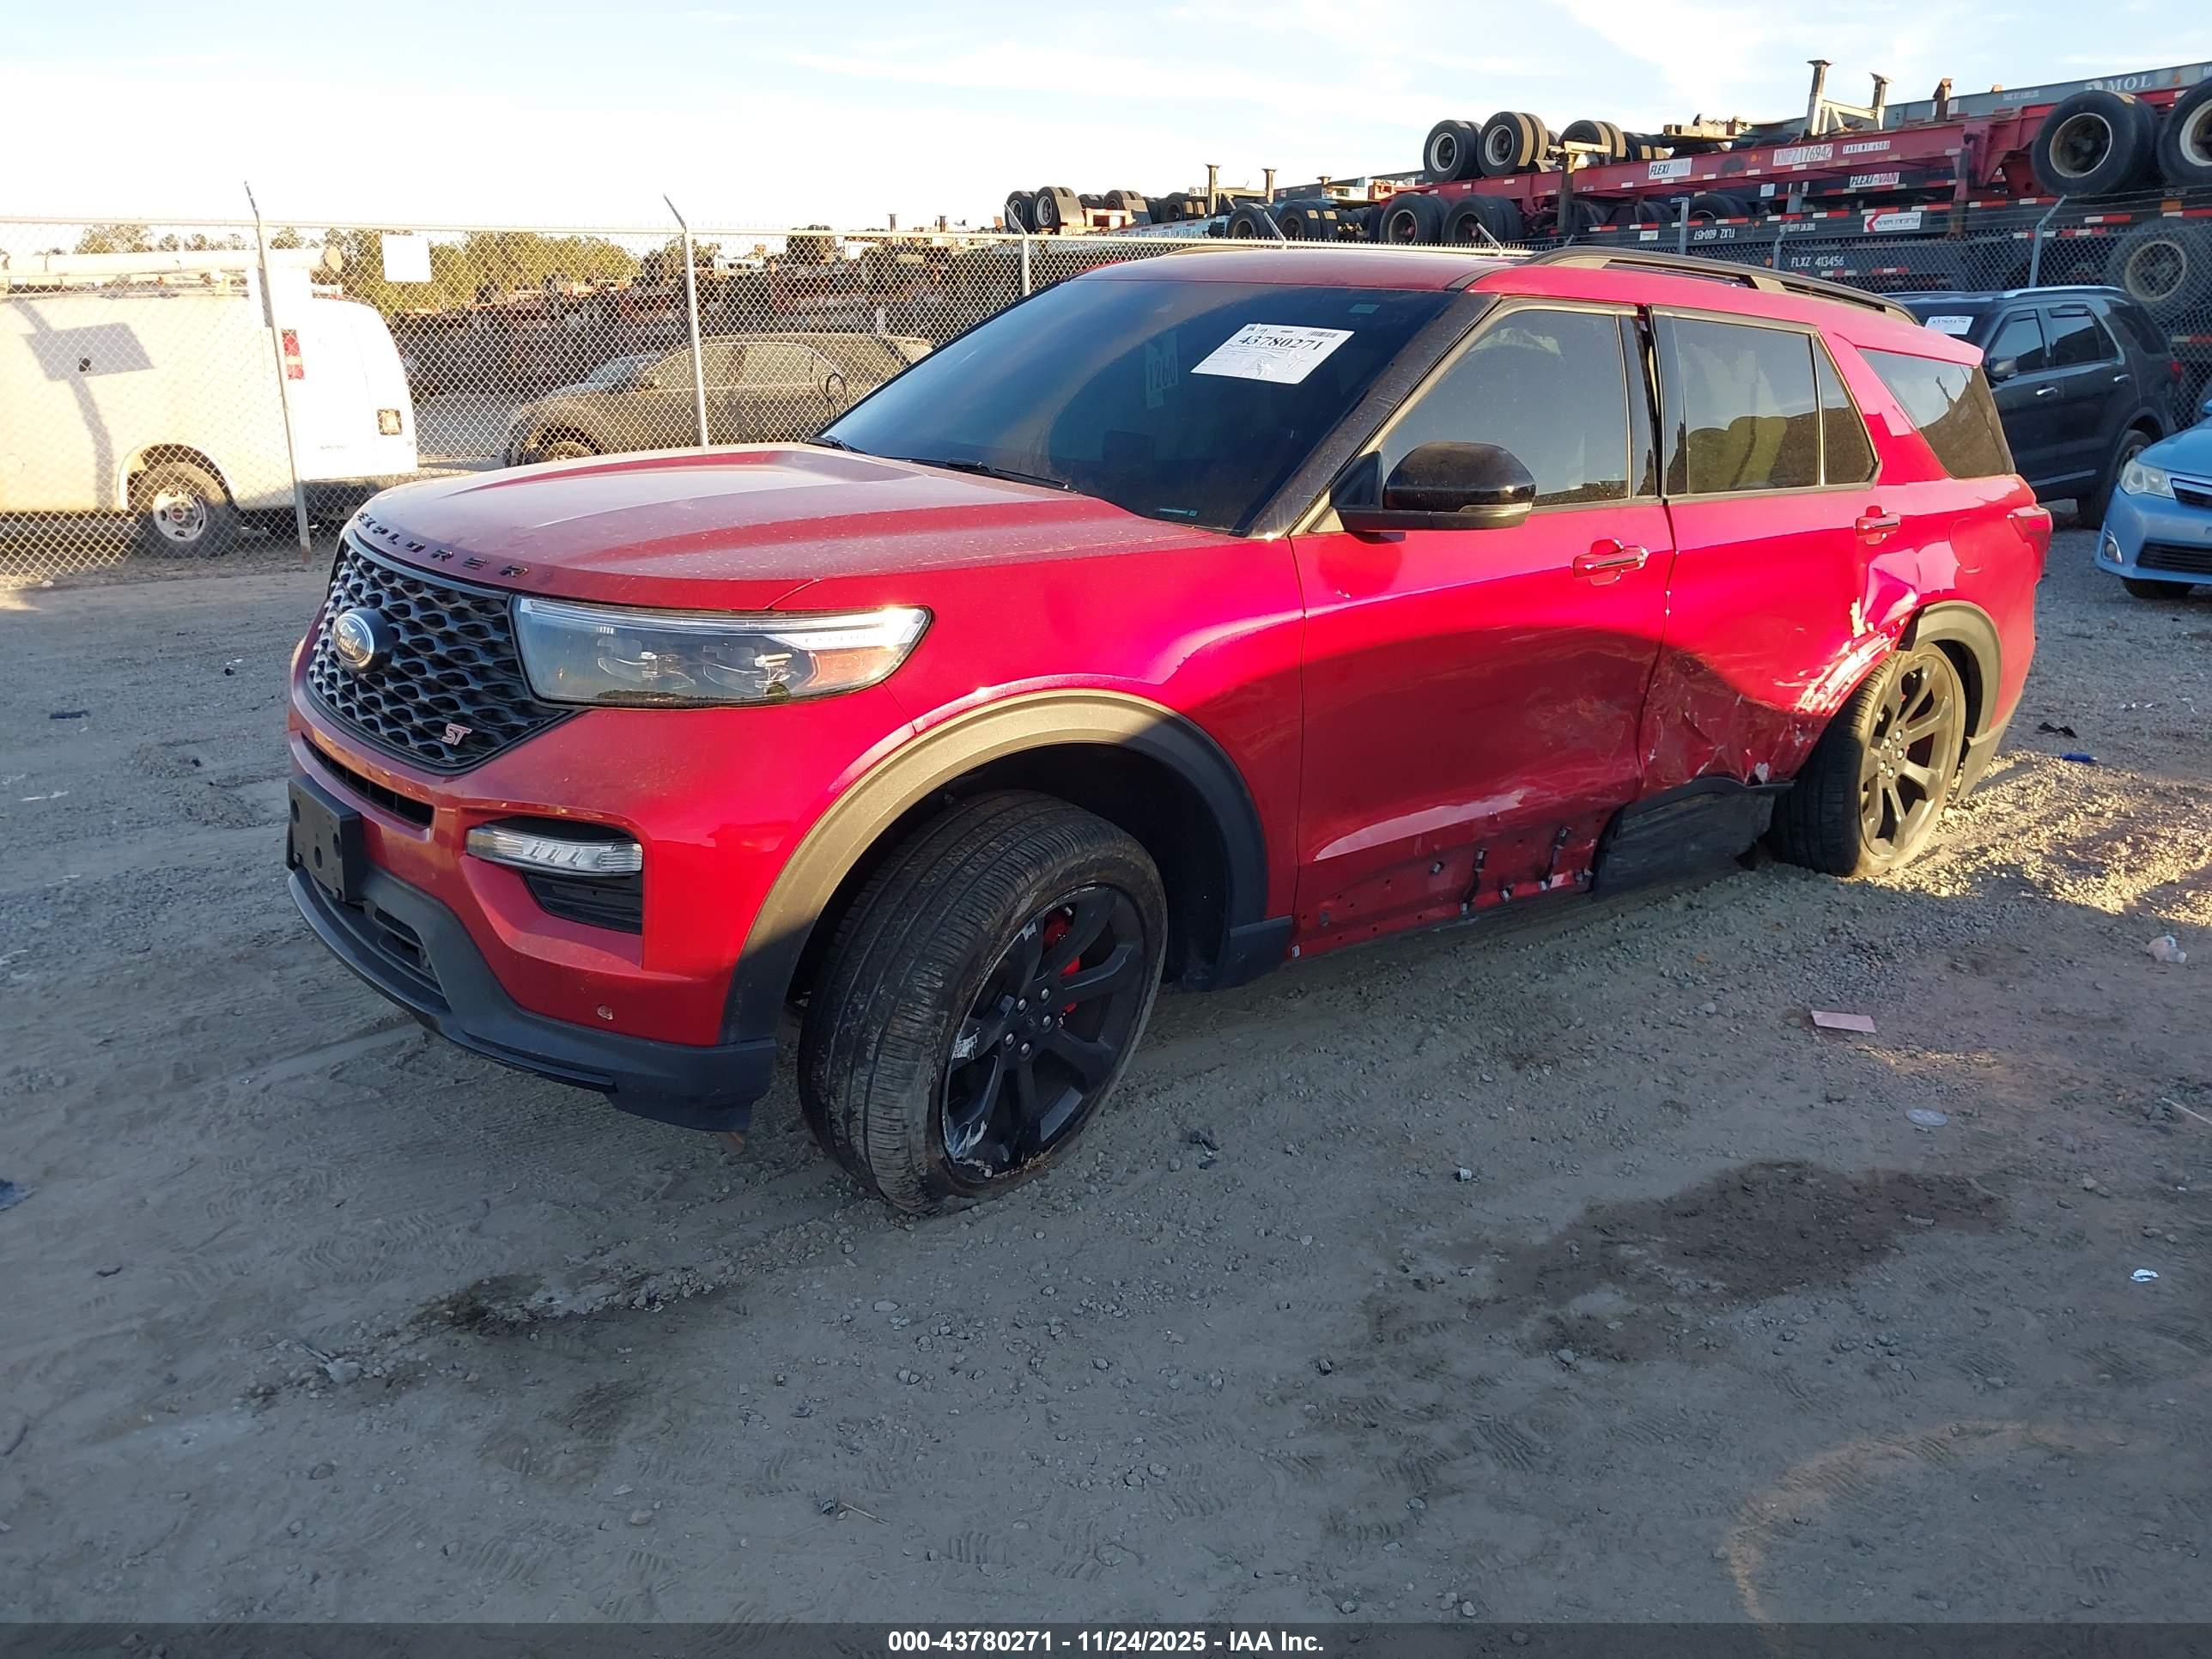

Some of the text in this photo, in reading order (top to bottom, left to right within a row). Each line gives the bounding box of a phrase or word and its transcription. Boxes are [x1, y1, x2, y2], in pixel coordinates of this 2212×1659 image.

[2108, 76, 2151, 91] MOL
[1851, 173, 1897, 185] FLEXI-VAN
[1790, 256, 1844, 267] FLXZ 413456
[1238, 334, 1325, 350] 43780271
[356, 512, 530, 578] EXPLORER
[441, 723, 472, 746] ST
